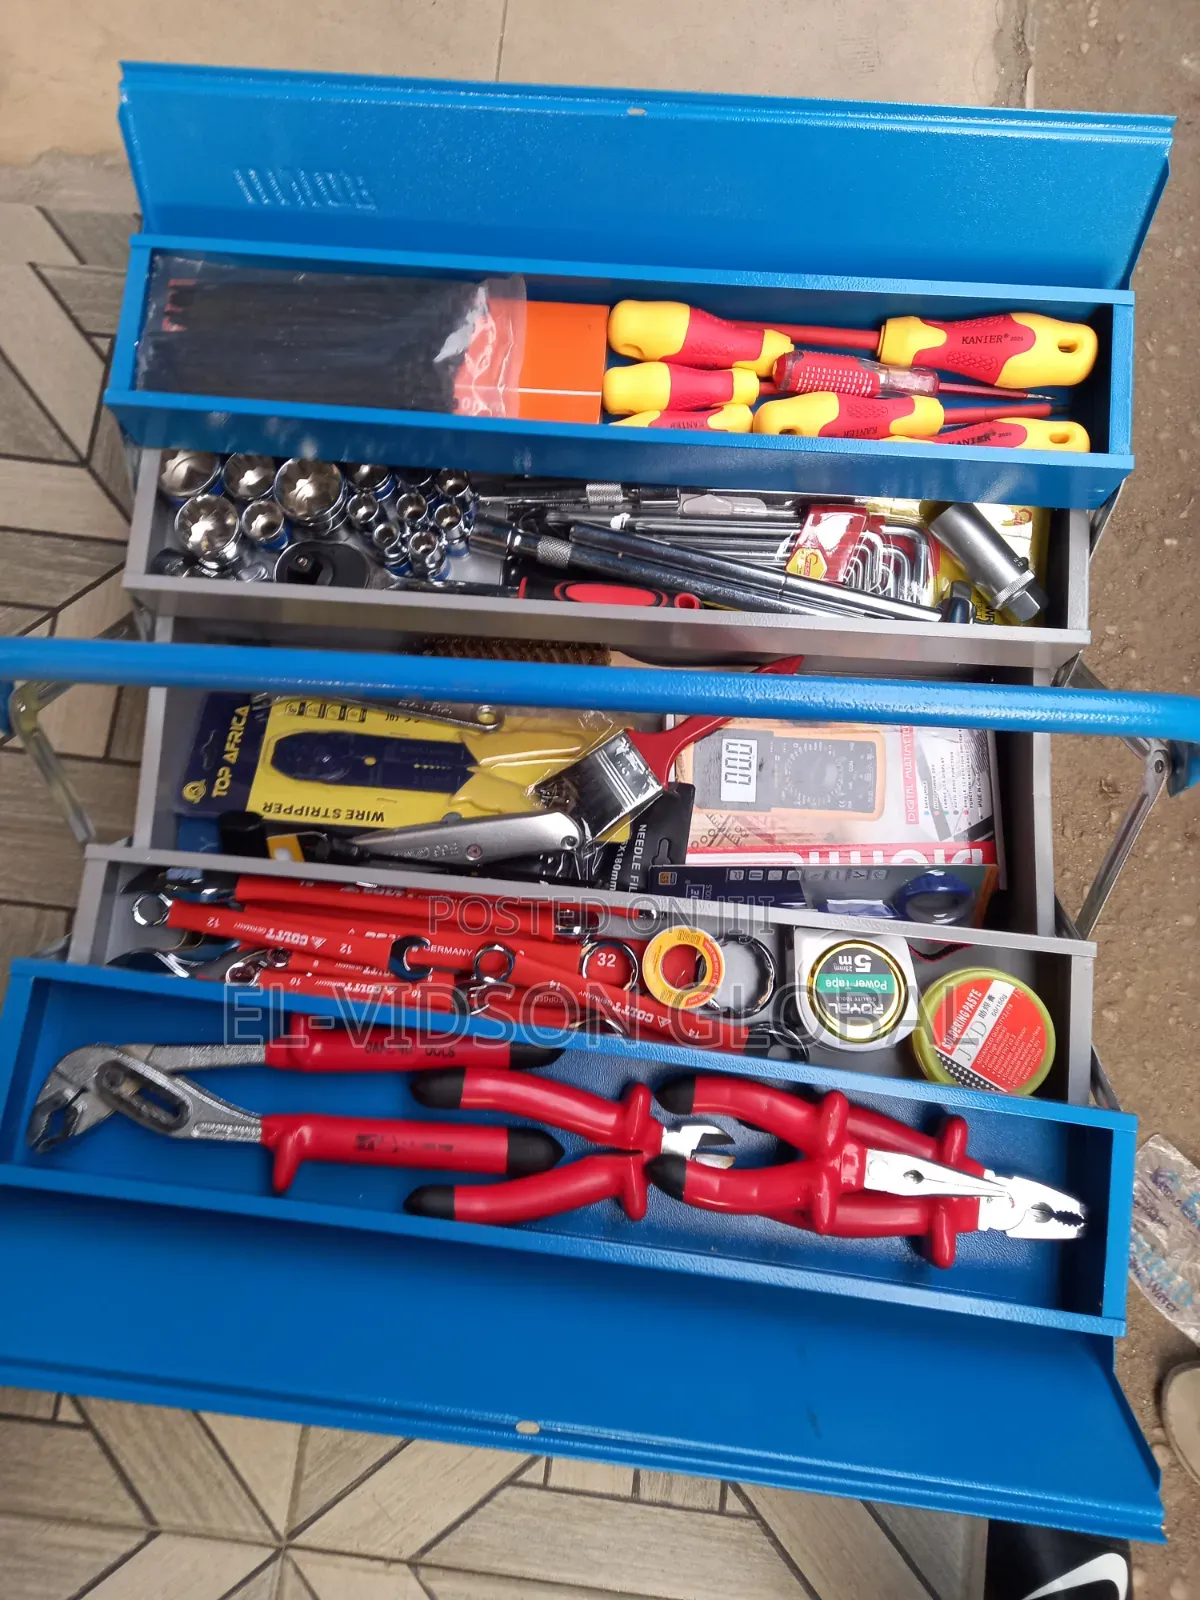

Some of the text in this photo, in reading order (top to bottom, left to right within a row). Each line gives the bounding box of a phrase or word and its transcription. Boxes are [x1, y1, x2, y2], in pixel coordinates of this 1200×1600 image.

[962, 334, 1003, 345] KANIER
[212, 704, 252, 799] TOP AFRICA
[905, 784, 917, 822] DIGITAL
[262, 801, 385, 823] WIRE STRIPPER
[631, 824, 647, 871] NEEDLE
[206, 916, 221, 928] 12
[339, 943, 352, 955] 12
[423, 945, 473, 956] GERMANY
[597, 952, 617, 967] 32
[853, 979, 887, 991] Power
[829, 1002, 884, 1015] ROYAL
[941, 988, 982, 1051] SOLDERING PASTE
